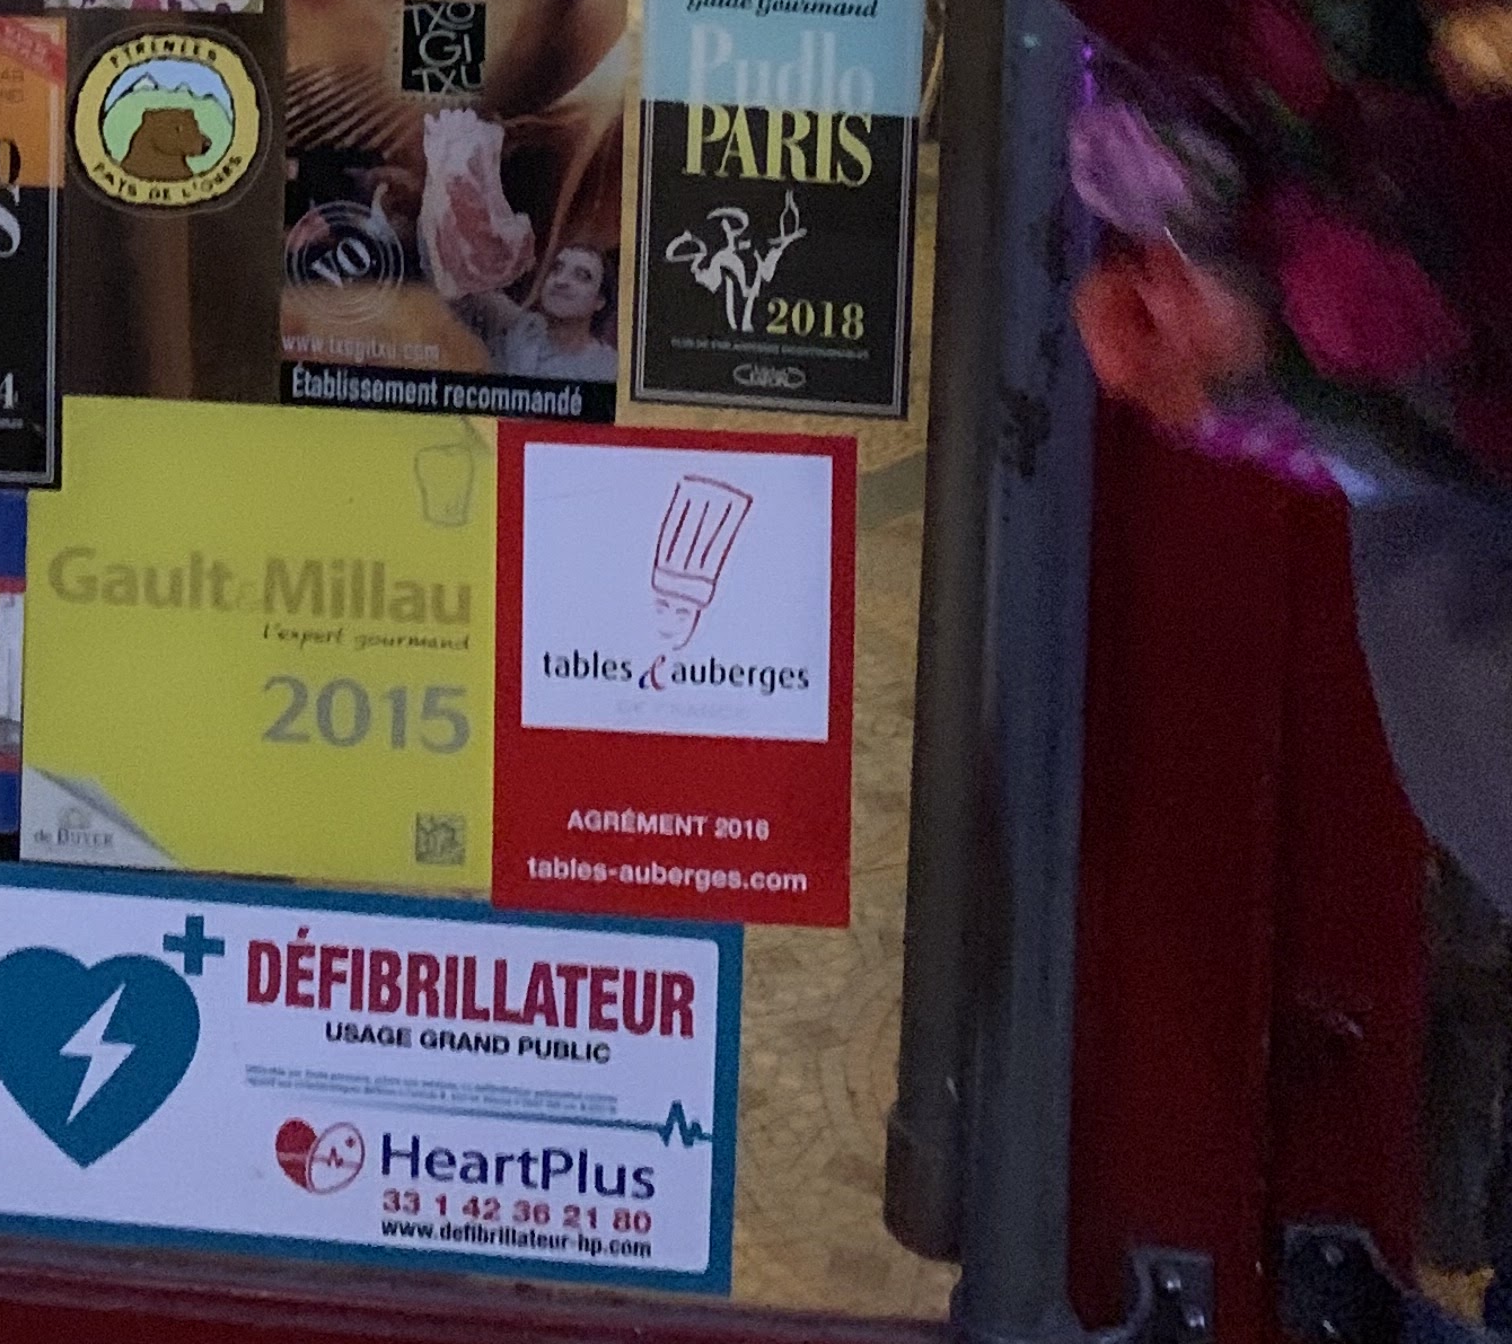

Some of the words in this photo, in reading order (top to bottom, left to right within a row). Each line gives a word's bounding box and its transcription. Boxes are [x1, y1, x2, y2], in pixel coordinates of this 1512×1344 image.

[690, 23, 876, 112] Pudlo
[682, 104, 873, 188] PARIS
[92, 162, 138, 197] PAYS
[148, 186, 171, 201] DE
[766, 296, 865, 341] 2018
[291, 362, 438, 407] Établissement
[443, 378, 584, 416] recommandé
[46, 545, 472, 626] Gault&Millau
[262, 621, 344, 651] l'expert
[354, 629, 470, 652] gourmand
[543, 649, 633, 682] tables
[671, 656, 811, 697] auberges
[261, 674, 471, 754] 2015
[526, 856, 808, 893] tables-auberges.com
[246, 925, 696, 1040] DÉFIBRILLATEUR
[325, 1021, 412, 1048] USAGE
[419, 1028, 511, 1056] GRAND
[517, 1036, 612, 1064] PUBLIC
[380, 1132, 656, 1200] HeartPlus
[382, 1187, 421, 1213] 33
[433, 1192, 448, 1216] 1
[461, 1196, 501, 1221] 42
[562, 1202, 599, 1229] 21
[612, 1207, 652, 1234] 80
[381, 1219, 652, 1259] www.defibrillateur-hp.com
